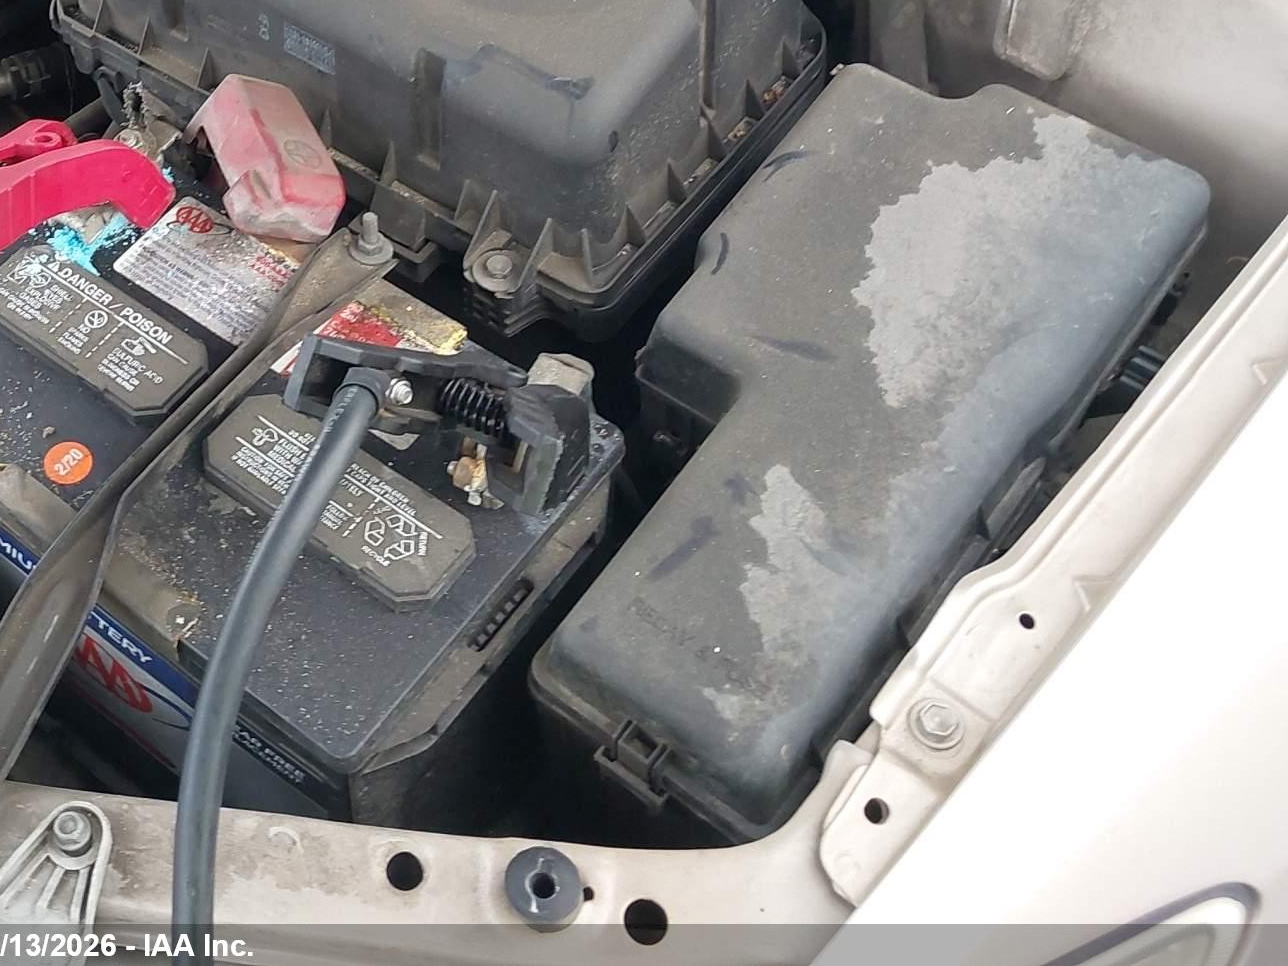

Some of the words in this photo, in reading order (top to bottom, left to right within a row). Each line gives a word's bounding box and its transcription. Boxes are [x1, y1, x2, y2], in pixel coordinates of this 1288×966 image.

[176, 206, 214, 233] AAA
[58, 267, 113, 305] DANGER
[120, 307, 174, 345] POISON
[77, 323, 91, 334] NO
[112, 347, 146, 372] SULFURIC
[143, 370, 164, 384] ACID
[272, 444, 292, 460] WITH
[278, 438, 303, 456] FLUSH
[53, 448, 85, 476] 2/20
[266, 450, 296, 473] MEDICAL
[396, 501, 417, 516] LEVEL
[360, 545, 392, 567] RECYCLE
[89, 610, 153, 663] TERY
[74, 634, 154, 713] AA
